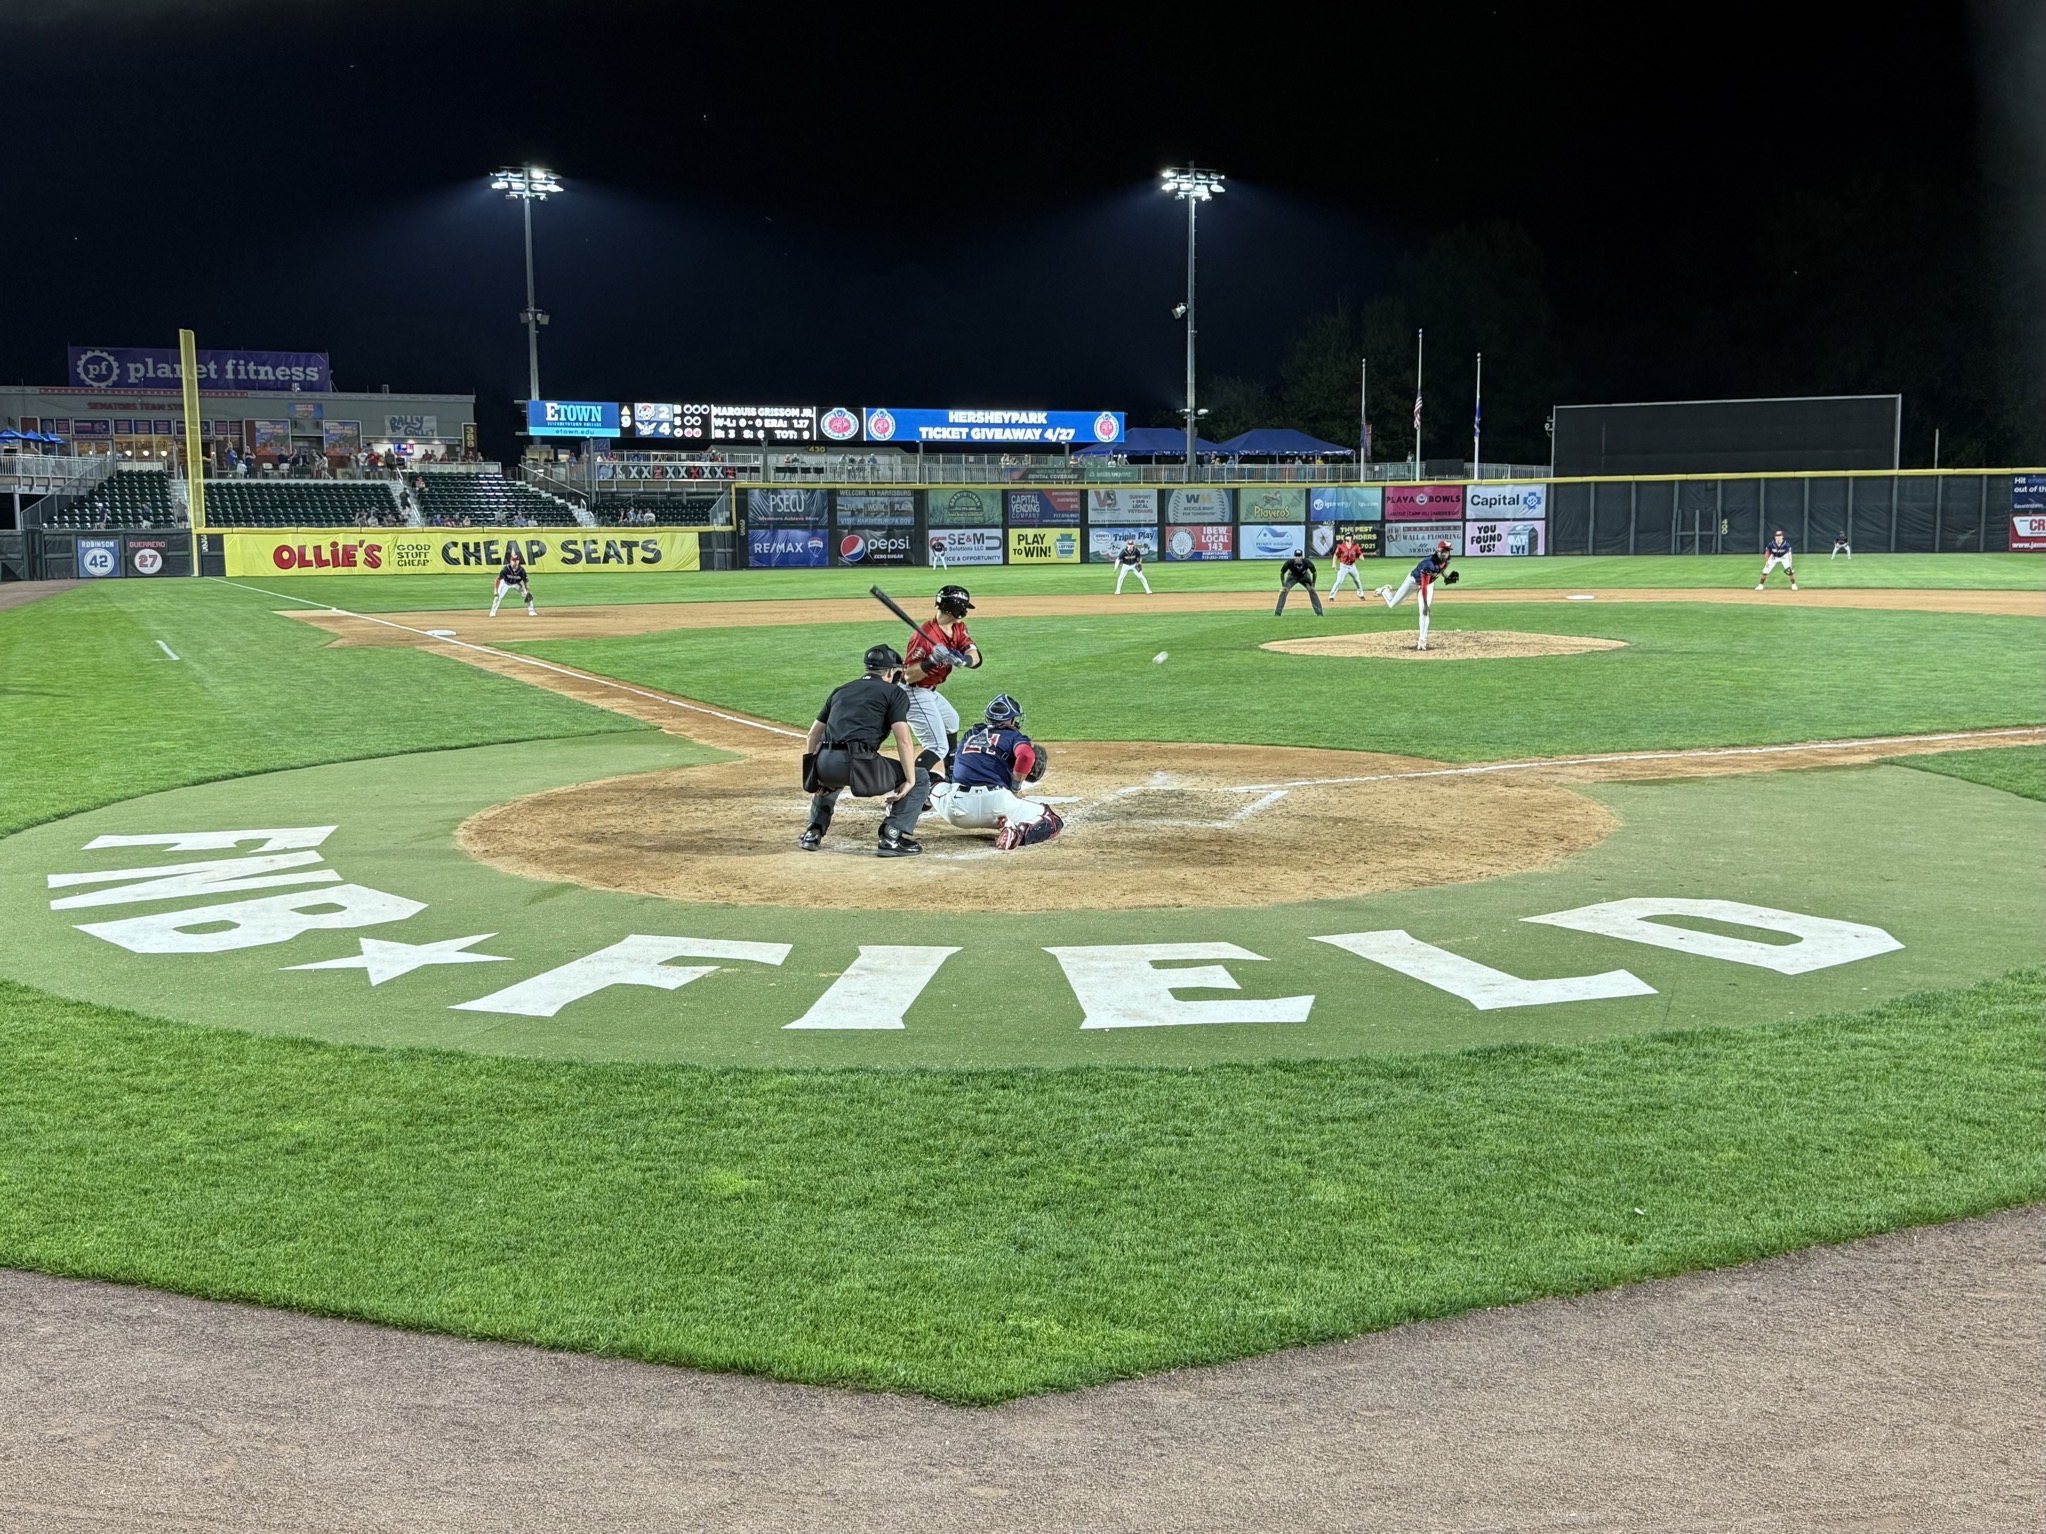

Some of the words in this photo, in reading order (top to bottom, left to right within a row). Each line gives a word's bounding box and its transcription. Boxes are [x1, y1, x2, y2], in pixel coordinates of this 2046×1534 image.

[88, 361, 108, 377] pf
[225, 359, 320, 381] fitness
[658, 406, 670, 418] 2
[713, 407, 757, 416] MARQUIS
[758, 408, 799, 416] GRISSOM
[948, 411, 1047, 424] HERSHEYPARK
[389, 416, 424, 432] RALLY
[620, 416, 631, 428] 9
[658, 422, 670, 436] 4
[919, 427, 968, 439] TICKET
[971, 428, 1043, 440] GIVEAWAY
[1044, 428, 1075, 440] 4/27
[466, 426, 475, 448] 388
[769, 494, 805, 512] PSECU
[1011, 495, 1040, 504] CAPITAL
[1470, 494, 1520, 508] Capital
[1011, 504, 1040, 512] VENDING
[1203, 526, 1227, 535] IBEW
[1477, 524, 1497, 534] YOU
[948, 533, 985, 545] SE&M
[1017, 534, 1046, 545] PLAY
[1113, 533, 1136, 541] Triple
[1138, 532, 1154, 541] Play
[1202, 535, 1229, 543] LOCAL
[1470, 534, 1503, 545] FOUND
[754, 542, 804, 554] RE/MAX
[868, 536, 909, 553] pepsi
[1479, 544, 1495, 553] US!
[441, 539, 547, 566] CHEAP
[560, 539, 663, 565] SEATS
[1024, 546, 1051, 558] WIN!
[89, 555, 108, 567] 42
[138, 555, 158, 567] 27
[48, 825, 429, 954] FNB
[451, 897, 1906, 1030] FIELD
